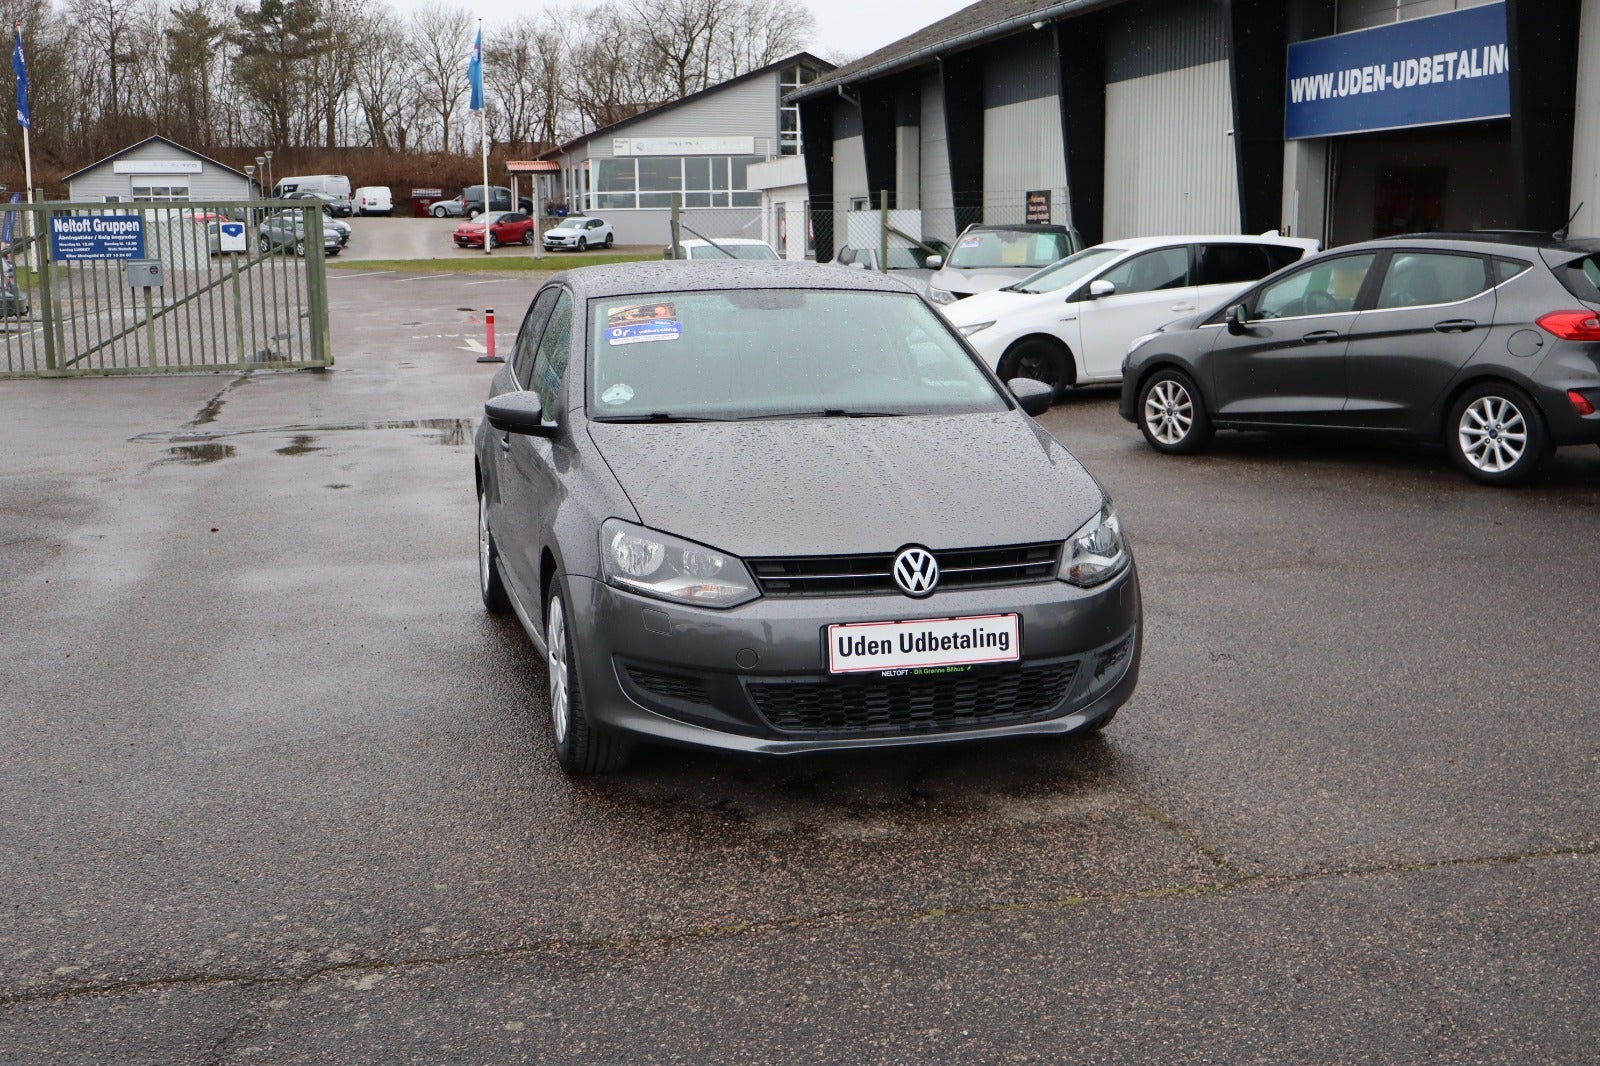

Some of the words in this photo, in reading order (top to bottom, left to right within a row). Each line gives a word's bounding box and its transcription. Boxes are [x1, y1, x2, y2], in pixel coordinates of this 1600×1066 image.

[1290, 43, 1509, 103] WWW.UDEN-UDBETALIN
[53, 218, 92, 233] Neltoft
[93, 217, 140, 234] Gruppen
[838, 635, 892, 657] Uden
[899, 627, 1010, 653] Udbetaling
[881, 669, 909, 677] NELTOFT
